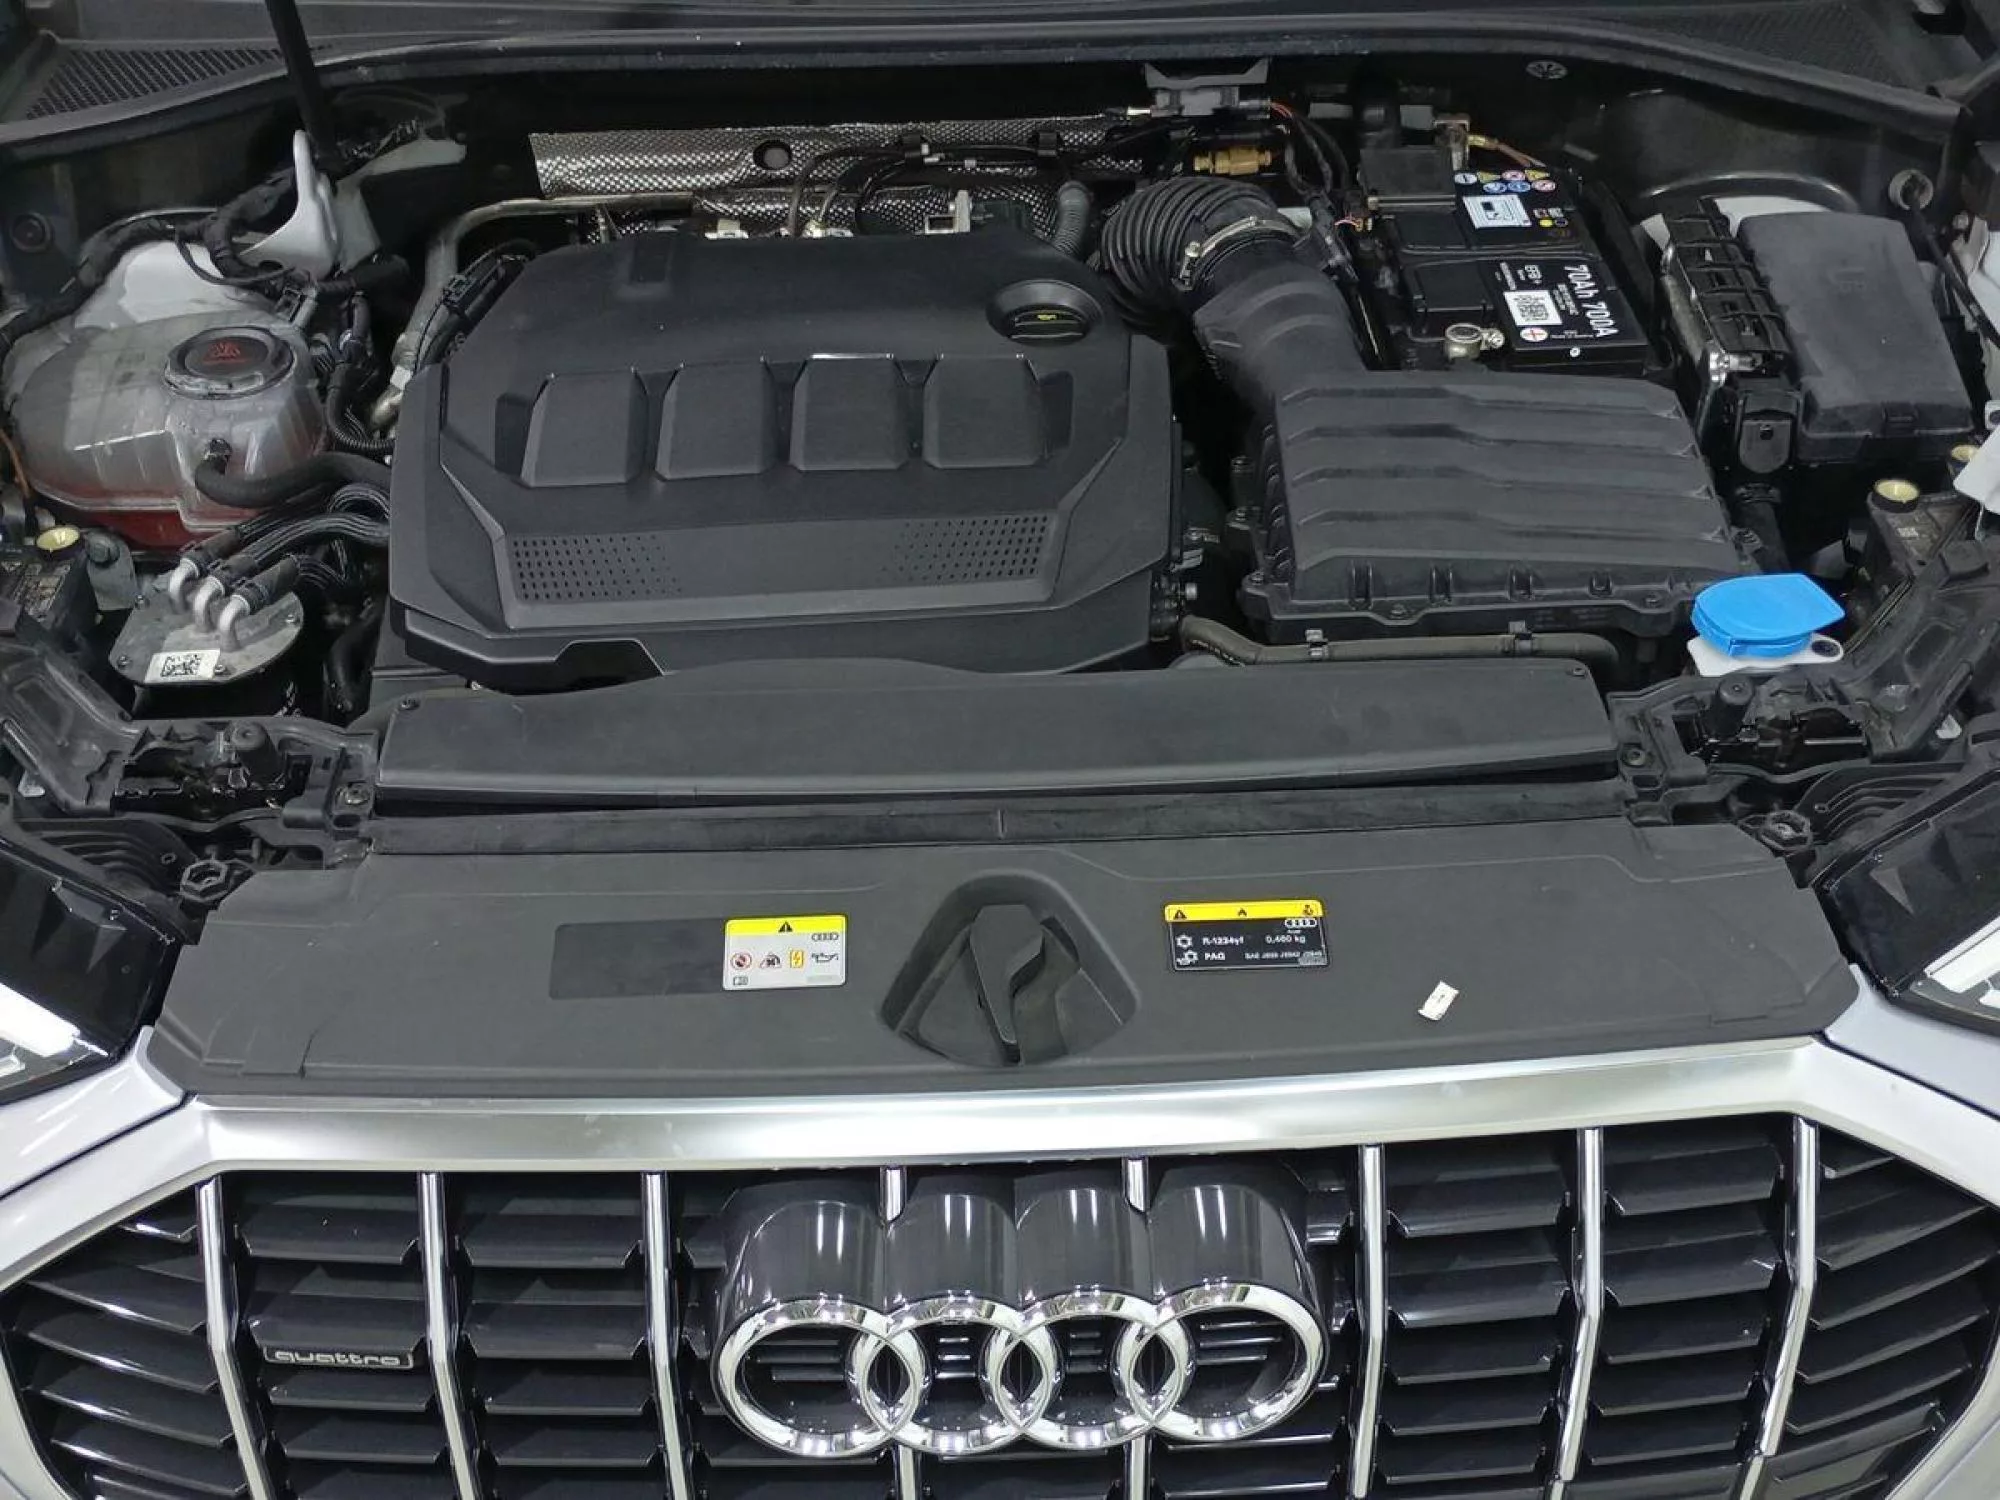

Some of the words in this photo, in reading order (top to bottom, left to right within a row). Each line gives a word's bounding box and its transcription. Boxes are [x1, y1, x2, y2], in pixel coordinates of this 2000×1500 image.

[1564, 264, 1599, 299] 70Ah
[1581, 301, 1619, 338] 700A
[1294, 934, 1306, 944] kg
[274, 1350, 401, 1366] quattro
